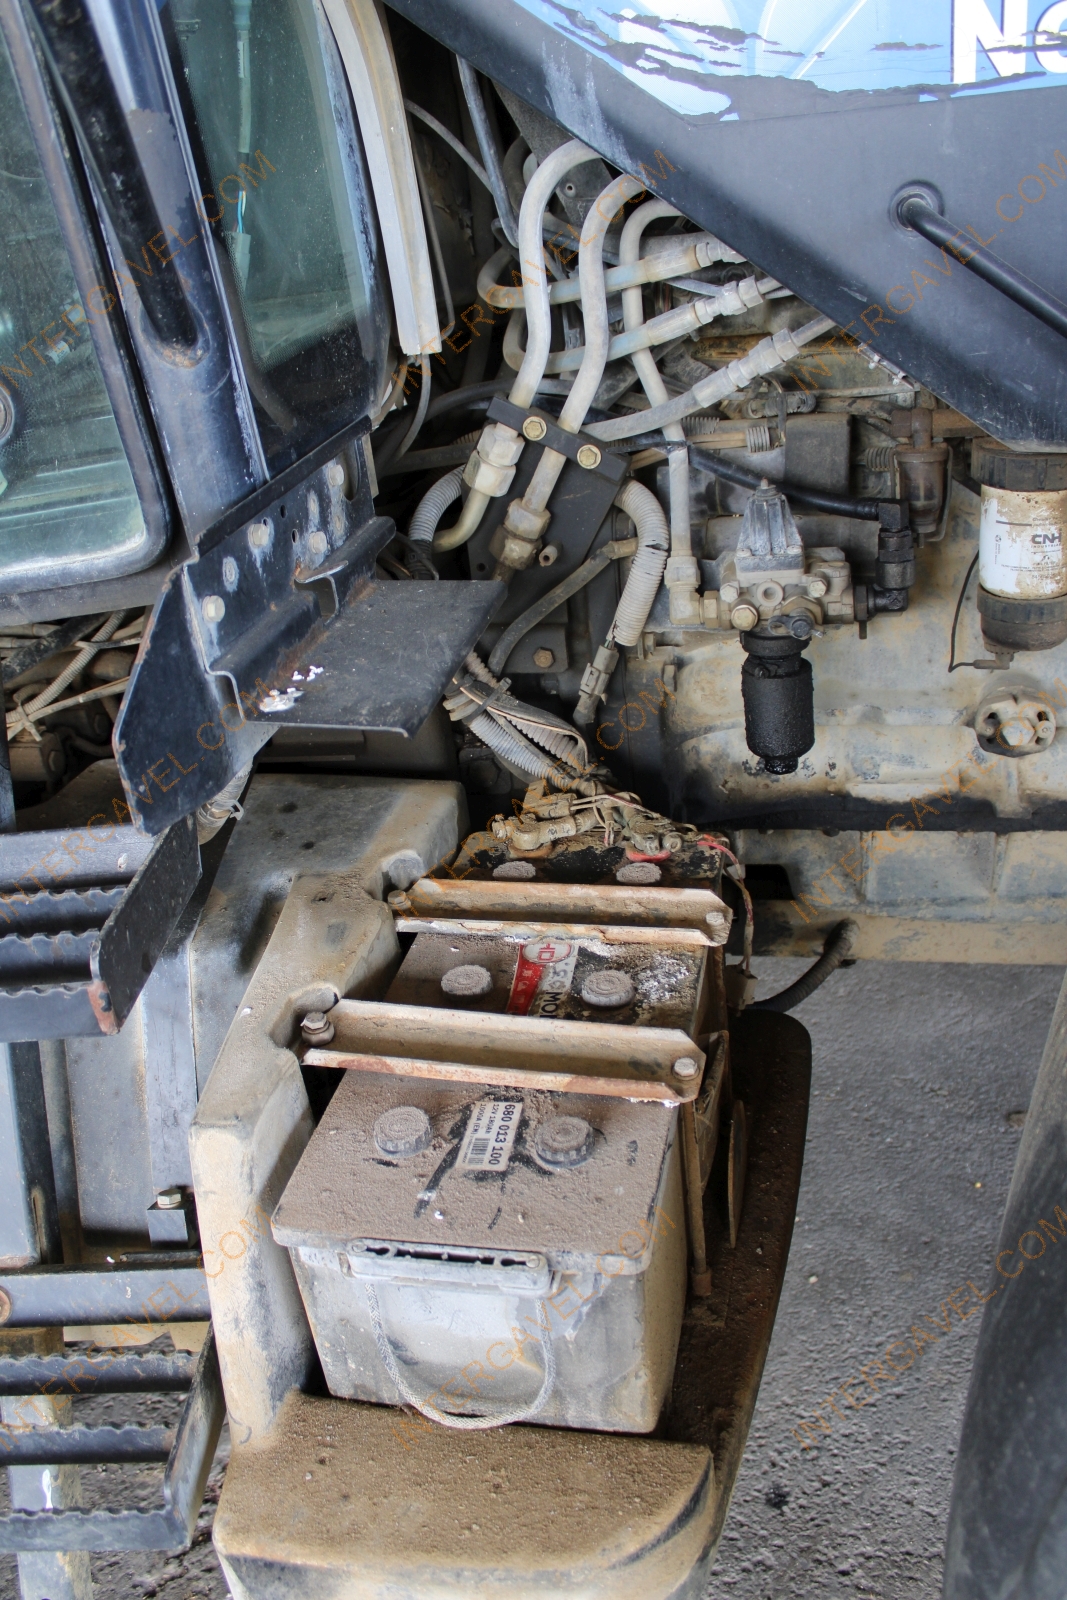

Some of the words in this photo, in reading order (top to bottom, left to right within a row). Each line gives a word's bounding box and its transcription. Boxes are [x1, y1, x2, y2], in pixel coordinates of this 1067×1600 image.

[1031, 533, 1062, 544] CNH
[474, 1103, 487, 1121] 1000A
[491, 1103, 499, 1115] 12V
[501, 1104, 516, 1122] 680
[485, 1116, 496, 1134] 180Ah
[495, 1124, 510, 1143] 013
[488, 1145, 504, 1165] 100
